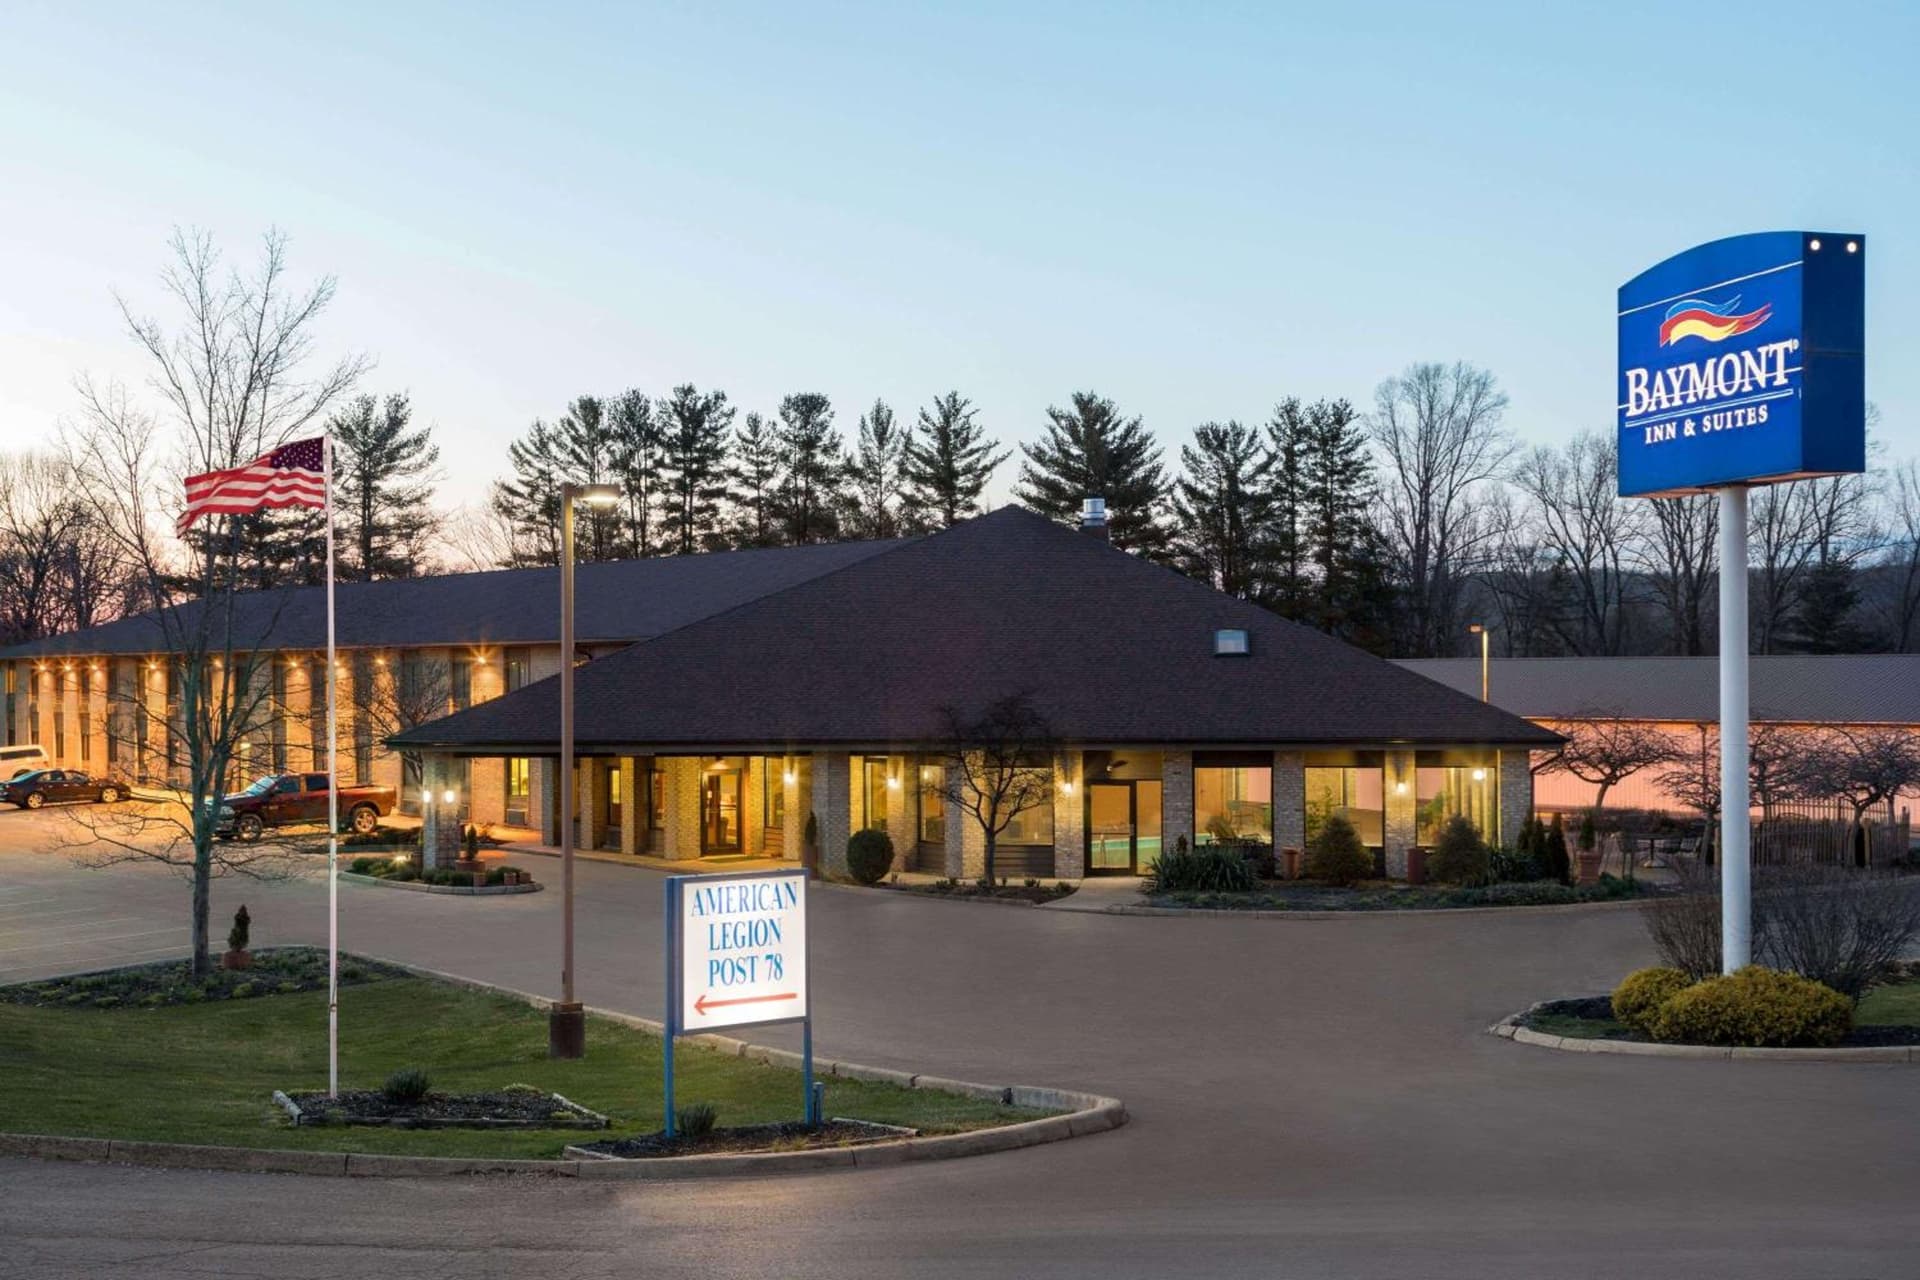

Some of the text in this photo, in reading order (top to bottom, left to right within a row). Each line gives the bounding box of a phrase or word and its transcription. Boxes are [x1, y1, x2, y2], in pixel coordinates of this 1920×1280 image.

[1625, 339, 1795, 417] BAYMONT
[1645, 404, 1769, 444] INN & SUITES
[691, 881, 797, 917] AMERICAN
[708, 918, 782, 951] LEGION
[708, 953, 783, 987] POST 78
